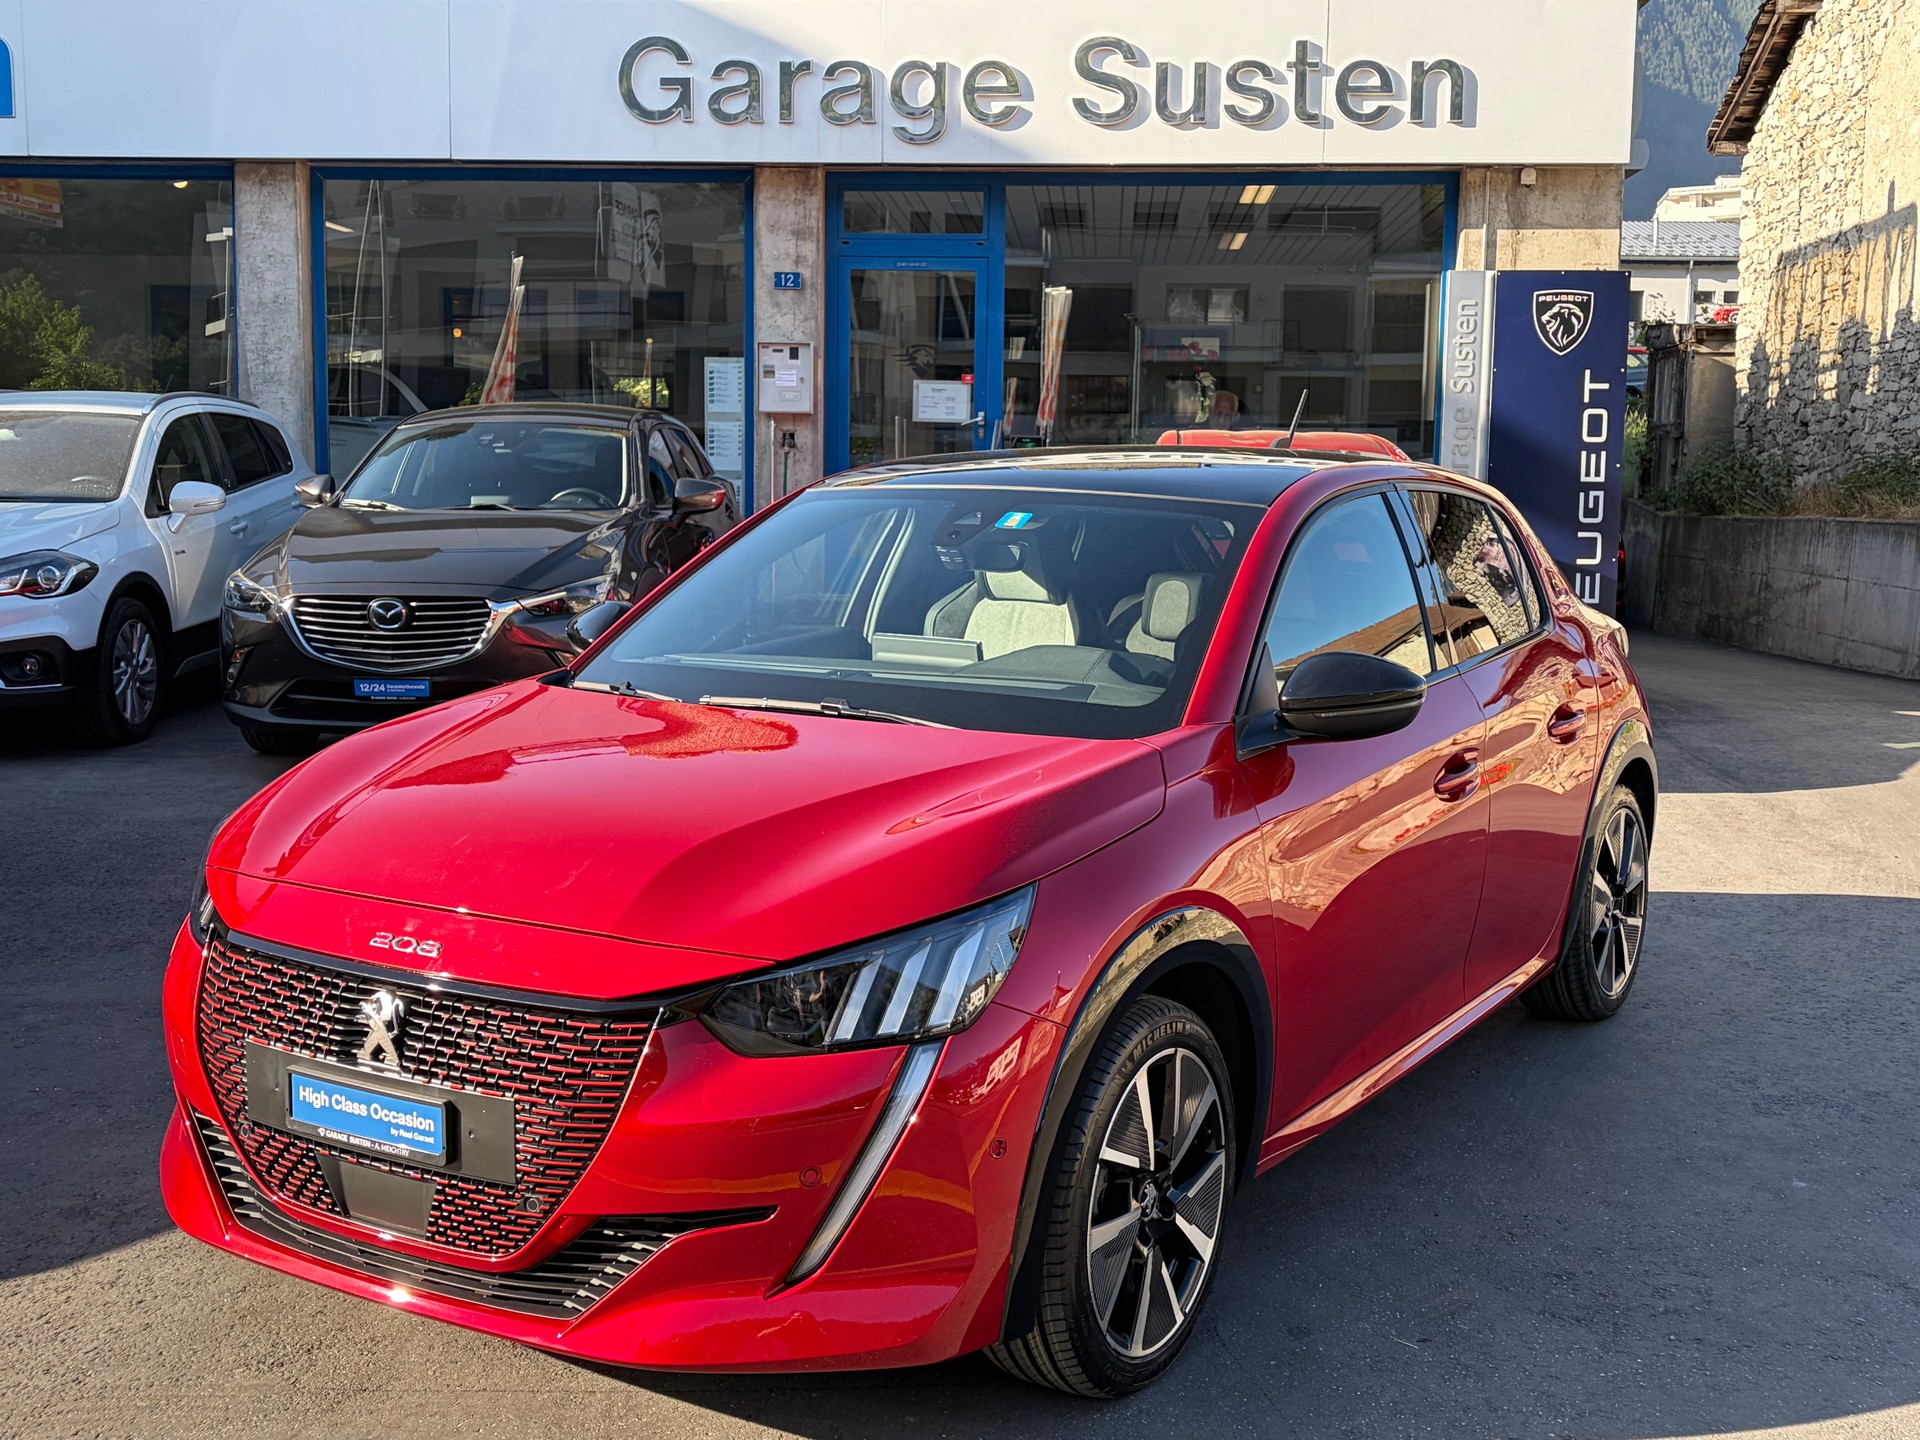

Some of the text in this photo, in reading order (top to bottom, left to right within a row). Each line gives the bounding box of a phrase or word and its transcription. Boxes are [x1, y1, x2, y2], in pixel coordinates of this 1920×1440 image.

[618, 36, 1465, 145] Garage Susten
[781, 274, 795, 287] 12
[1538, 294, 1589, 303] PEUGEOT
[1450, 299, 1478, 394] Susten
[359, 683, 386, 692] 12/24
[368, 931, 444, 958] 208
[1132, 1021, 1183, 1060] MICHELIN
[299, 1085, 435, 1131] High Class Occasion
[325, 1130, 348, 1142] GARAGE
[349, 1135, 370, 1148] SUSTEN
[390, 1127, 399, 1137] by
